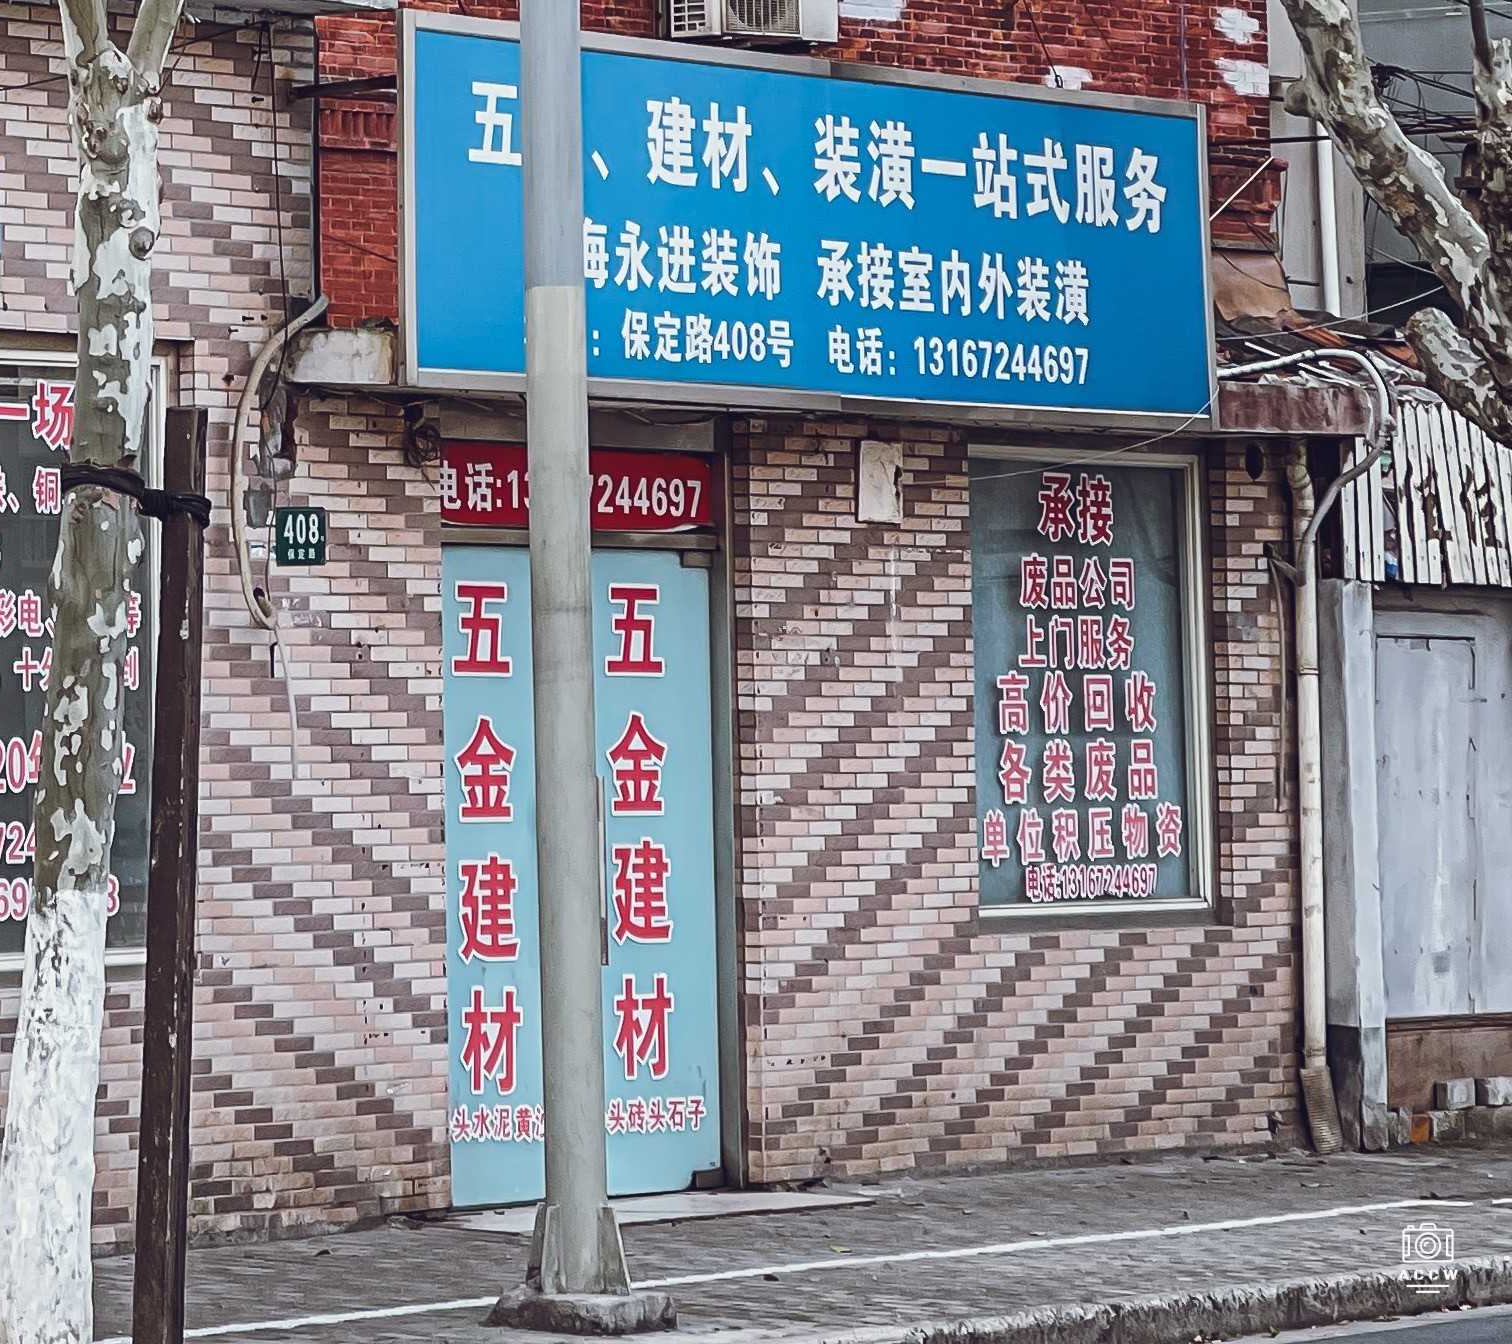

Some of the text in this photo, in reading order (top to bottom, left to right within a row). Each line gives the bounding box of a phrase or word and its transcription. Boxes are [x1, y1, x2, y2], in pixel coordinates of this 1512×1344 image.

[468, 81, 1167, 234] 五、建材、装潢一站式服务
[816, 239, 1090, 326] 承接室内外装潢
[283, 514, 319, 544] 408
[1037, 471, 1114, 546] 承接
[1019, 552, 1135, 611] 废品公司
[1018, 614, 1135, 671] 上门服务
[996, 669, 1157, 736] 高价回收
[998, 737, 1159, 805] 各类废品
[452, 580, 523, 1095] 五金建材
[605, 583, 674, 1081] 五金建材
[981, 801, 1182, 868] 单位积压物资
[1024, 861, 1158, 904] 电话:13167244697
